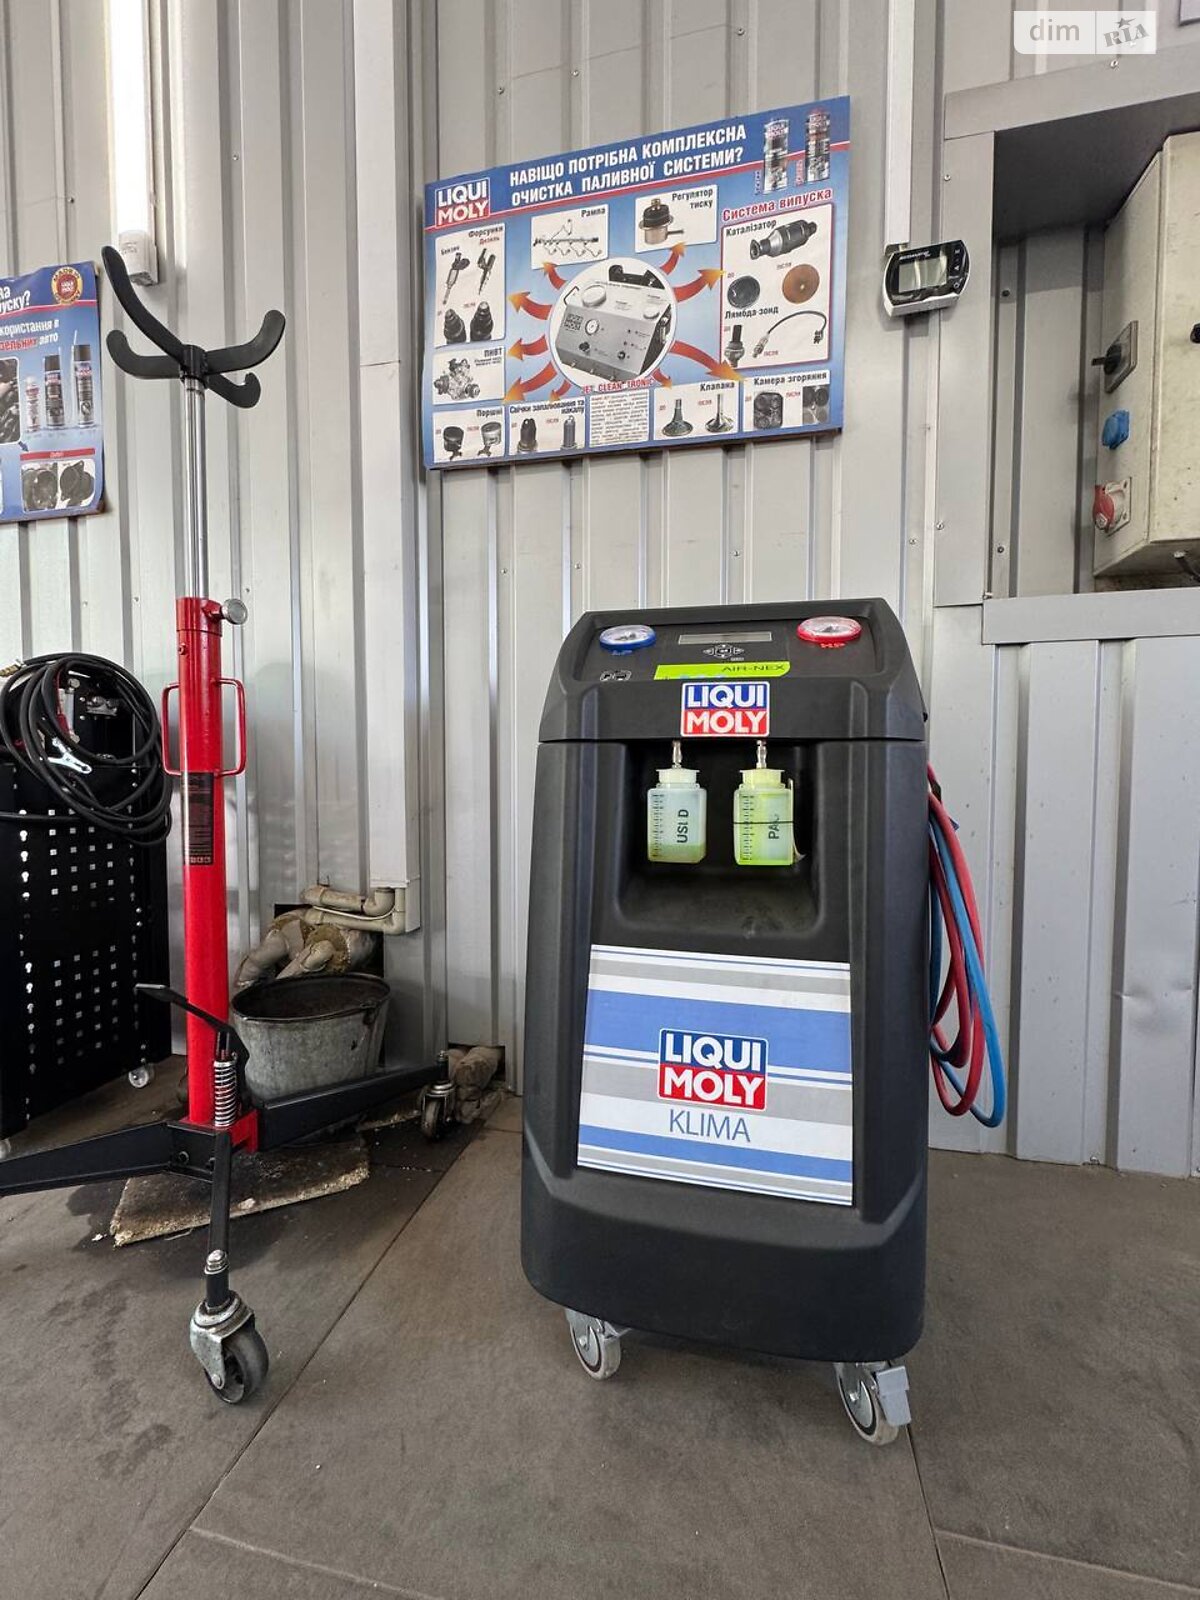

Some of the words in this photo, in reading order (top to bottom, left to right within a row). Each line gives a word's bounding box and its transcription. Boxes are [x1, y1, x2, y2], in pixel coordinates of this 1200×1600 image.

[510, 162, 565, 187] НАВІЩО
[568, 146, 638, 174] ПОТРІБНА
[642, 124, 747, 158] КОМПЛЕКСНА
[511, 181, 573, 206] ОЧИСТКА
[581, 163, 654, 192] ПАЛИВНОЇ
[663, 147, 744, 176] СИСТЕМИ?
[437, 180, 488, 207] LIQUI
[671, 188, 713, 201] Регулятор
[690, 199, 713, 209] тиску
[722, 201, 776, 222] Система
[779, 189, 832, 209] випуска
[437, 201, 489, 226] MOLY
[581, 207, 606, 218] Рампа
[725, 219, 777, 237] Каталізатор
[598, 381, 622, 392] CLEAN
[699, 381, 735, 392] Клапана
[754, 376, 785, 386] Камера
[788, 372, 827, 384] згоряння
[686, 685, 765, 709] LIQUI
[686, 711, 767, 733] MOLY
[666, 1033, 761, 1071] LIQUI
[664, 1067, 764, 1106] MOLY
[669, 1108, 751, 1142] KLIMA
